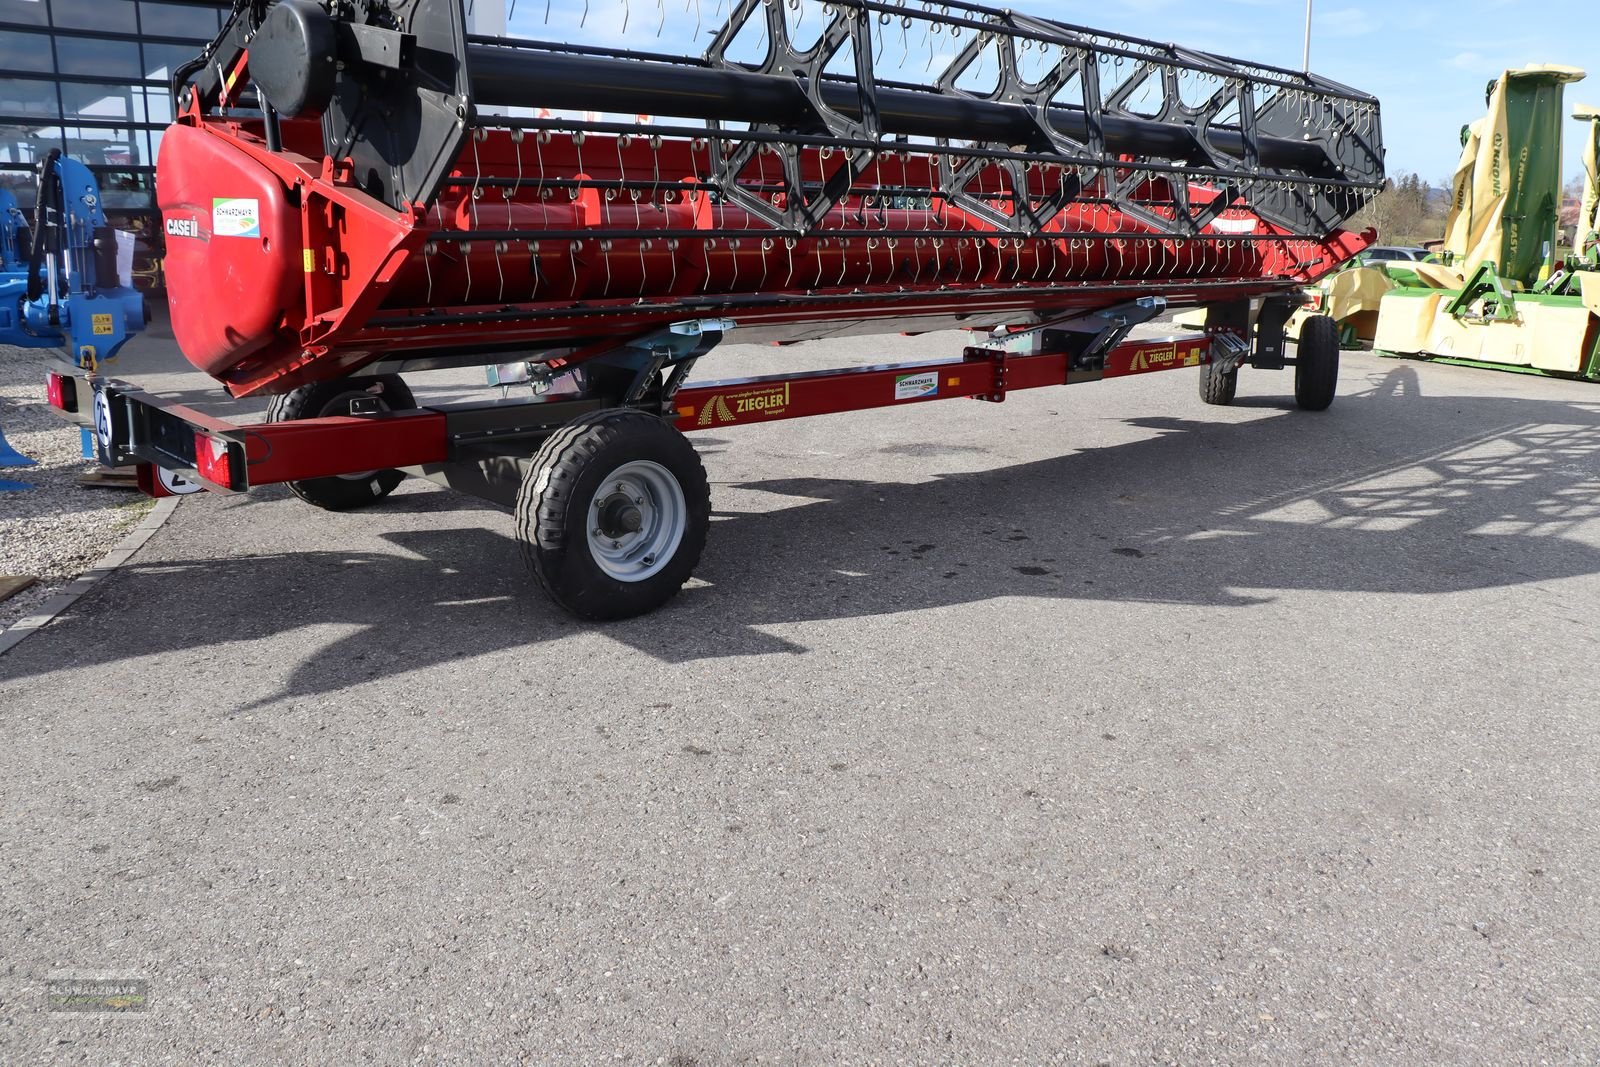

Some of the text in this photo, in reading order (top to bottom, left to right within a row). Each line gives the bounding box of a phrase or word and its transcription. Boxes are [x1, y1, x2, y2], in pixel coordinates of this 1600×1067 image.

[166, 218, 191, 237] CASE
[1149, 351, 1173, 363] ZIEGLER
[736, 394, 784, 413] ZIEGLER
[97, 401, 108, 437] 25
